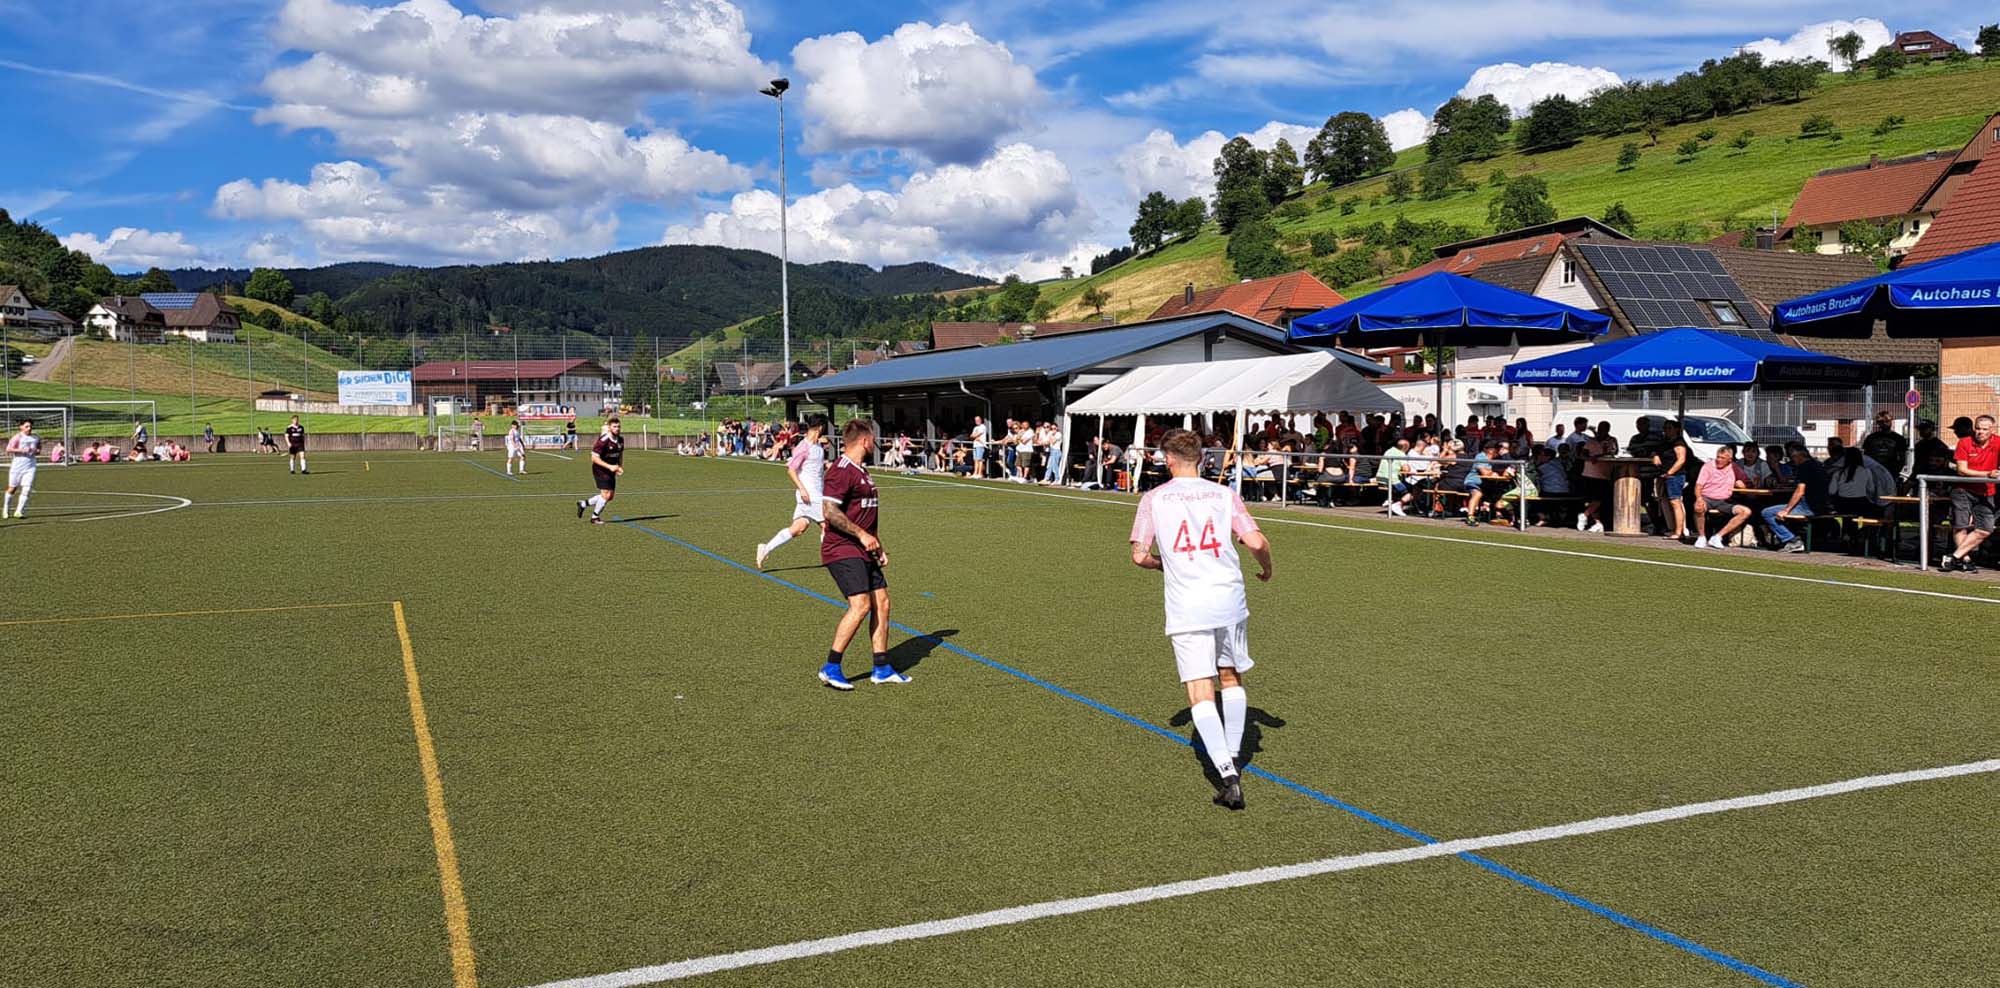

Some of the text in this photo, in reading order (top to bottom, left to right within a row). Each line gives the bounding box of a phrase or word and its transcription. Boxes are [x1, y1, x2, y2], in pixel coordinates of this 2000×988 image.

[1910, 287, 1992, 301] Autohaus
[1784, 302, 1827, 318] Autohaus
[1515, 368, 1580, 378] Autohaus Brucher
[1623, 366, 1735, 379] Autohaus Brucher
[1173, 517, 1222, 560] 44
